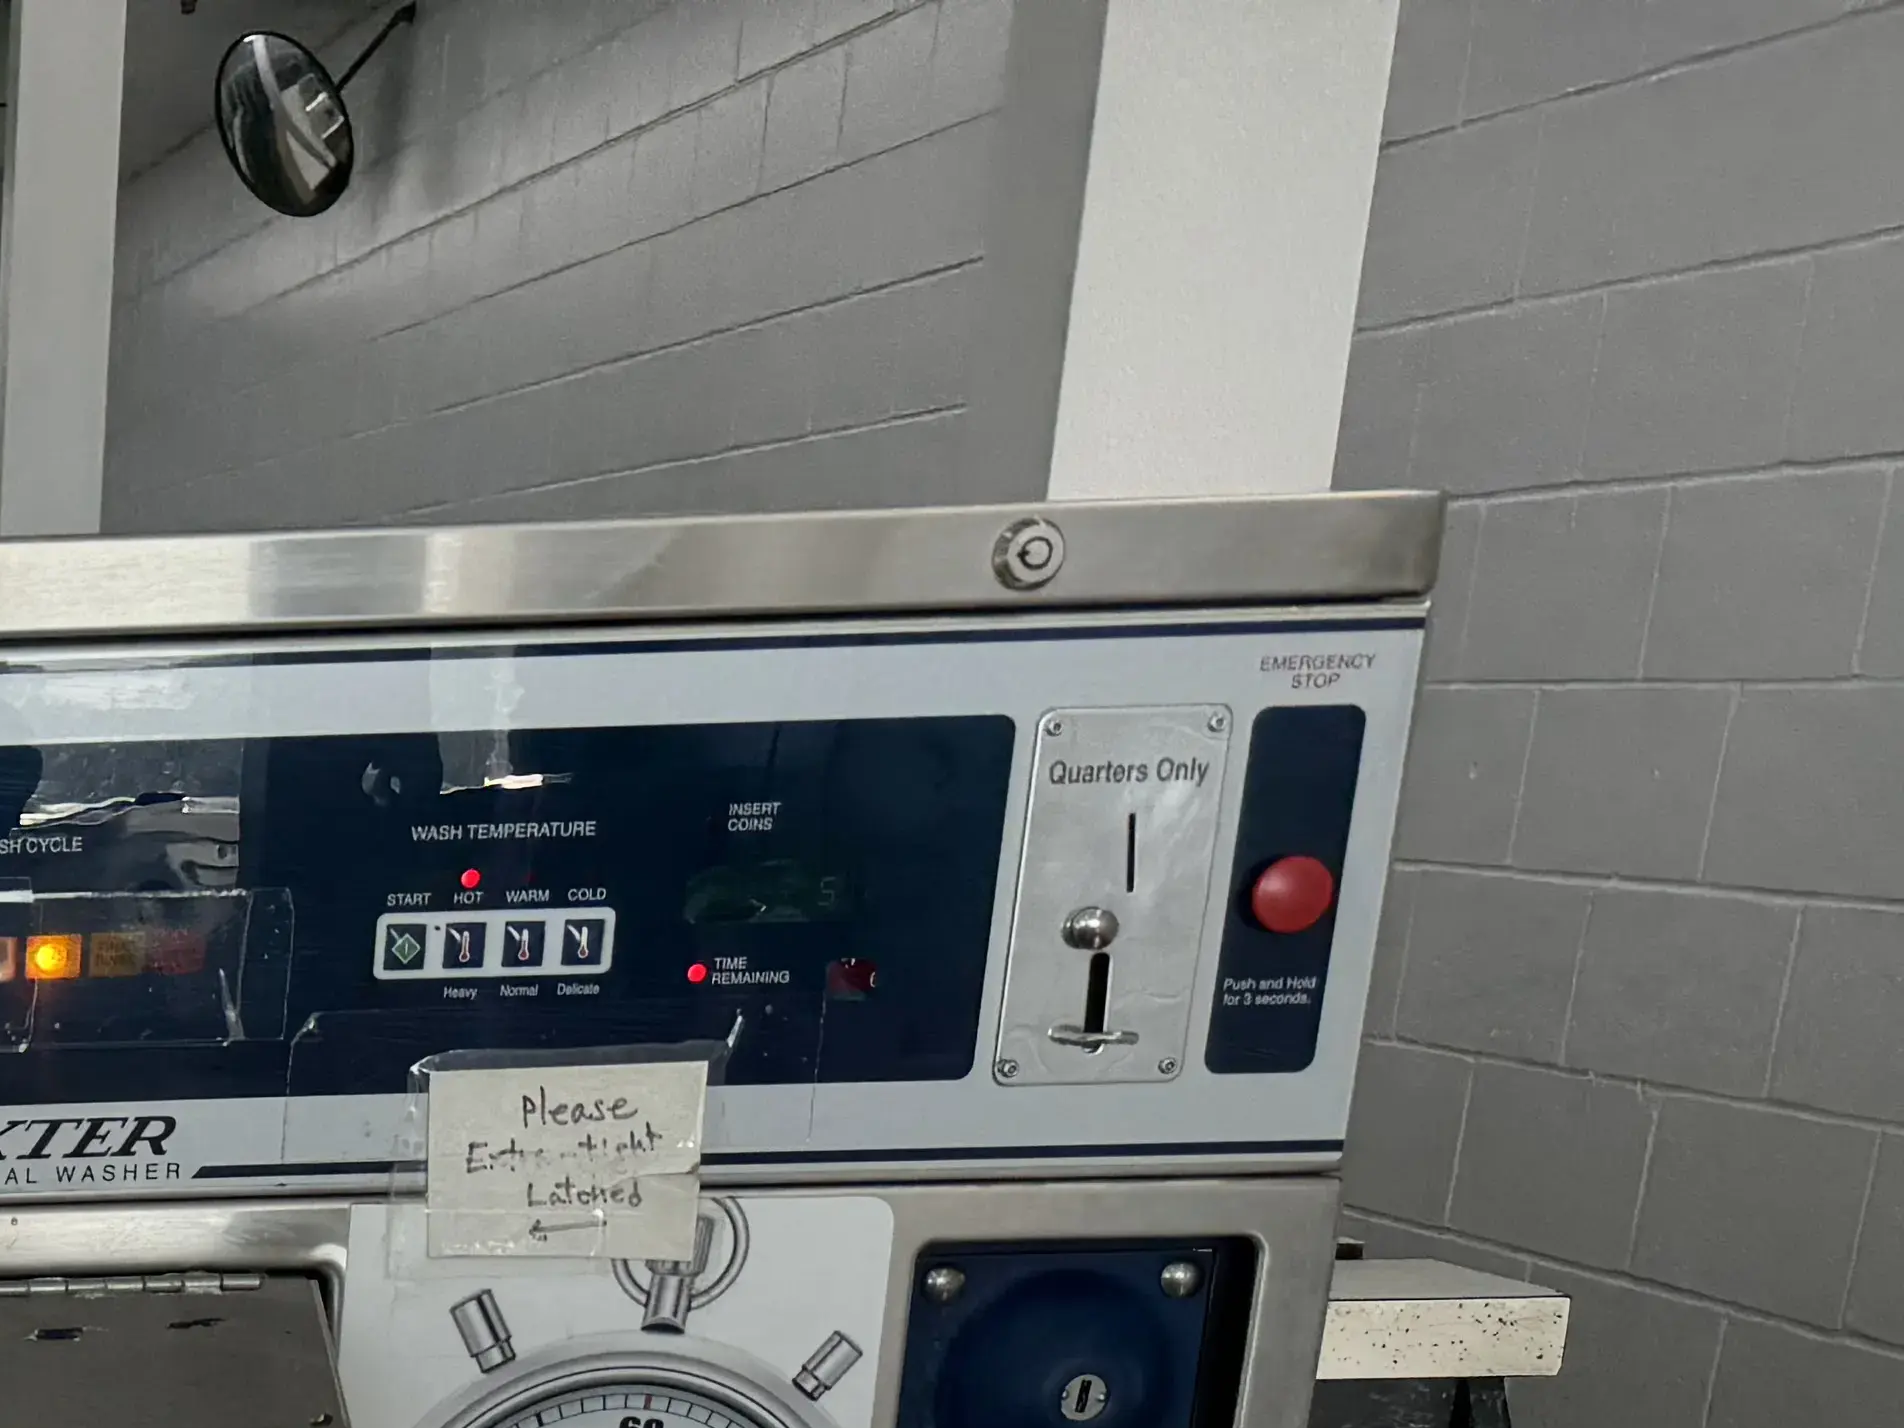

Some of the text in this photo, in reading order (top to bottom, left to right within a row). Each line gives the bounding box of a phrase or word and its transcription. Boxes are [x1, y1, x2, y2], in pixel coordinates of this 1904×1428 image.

[1260, 653, 1375, 672] EMERGENCY
[1291, 673, 1340, 689] STOP
[1049, 757, 1209, 787] Quarters Only
[729, 802, 781, 815] INSERT
[412, 821, 596, 841] WASH TEMPERATURE
[728, 817, 773, 831] COINS
[25, 836, 83, 854] CYCLE
[387, 888, 606, 906] START HOT WARM COLD
[714, 957, 747, 969] TIME
[712, 971, 789, 984] REMAINING
[522, 1086, 638, 1128] Please
[56, 1163, 179, 1182] WASHER
